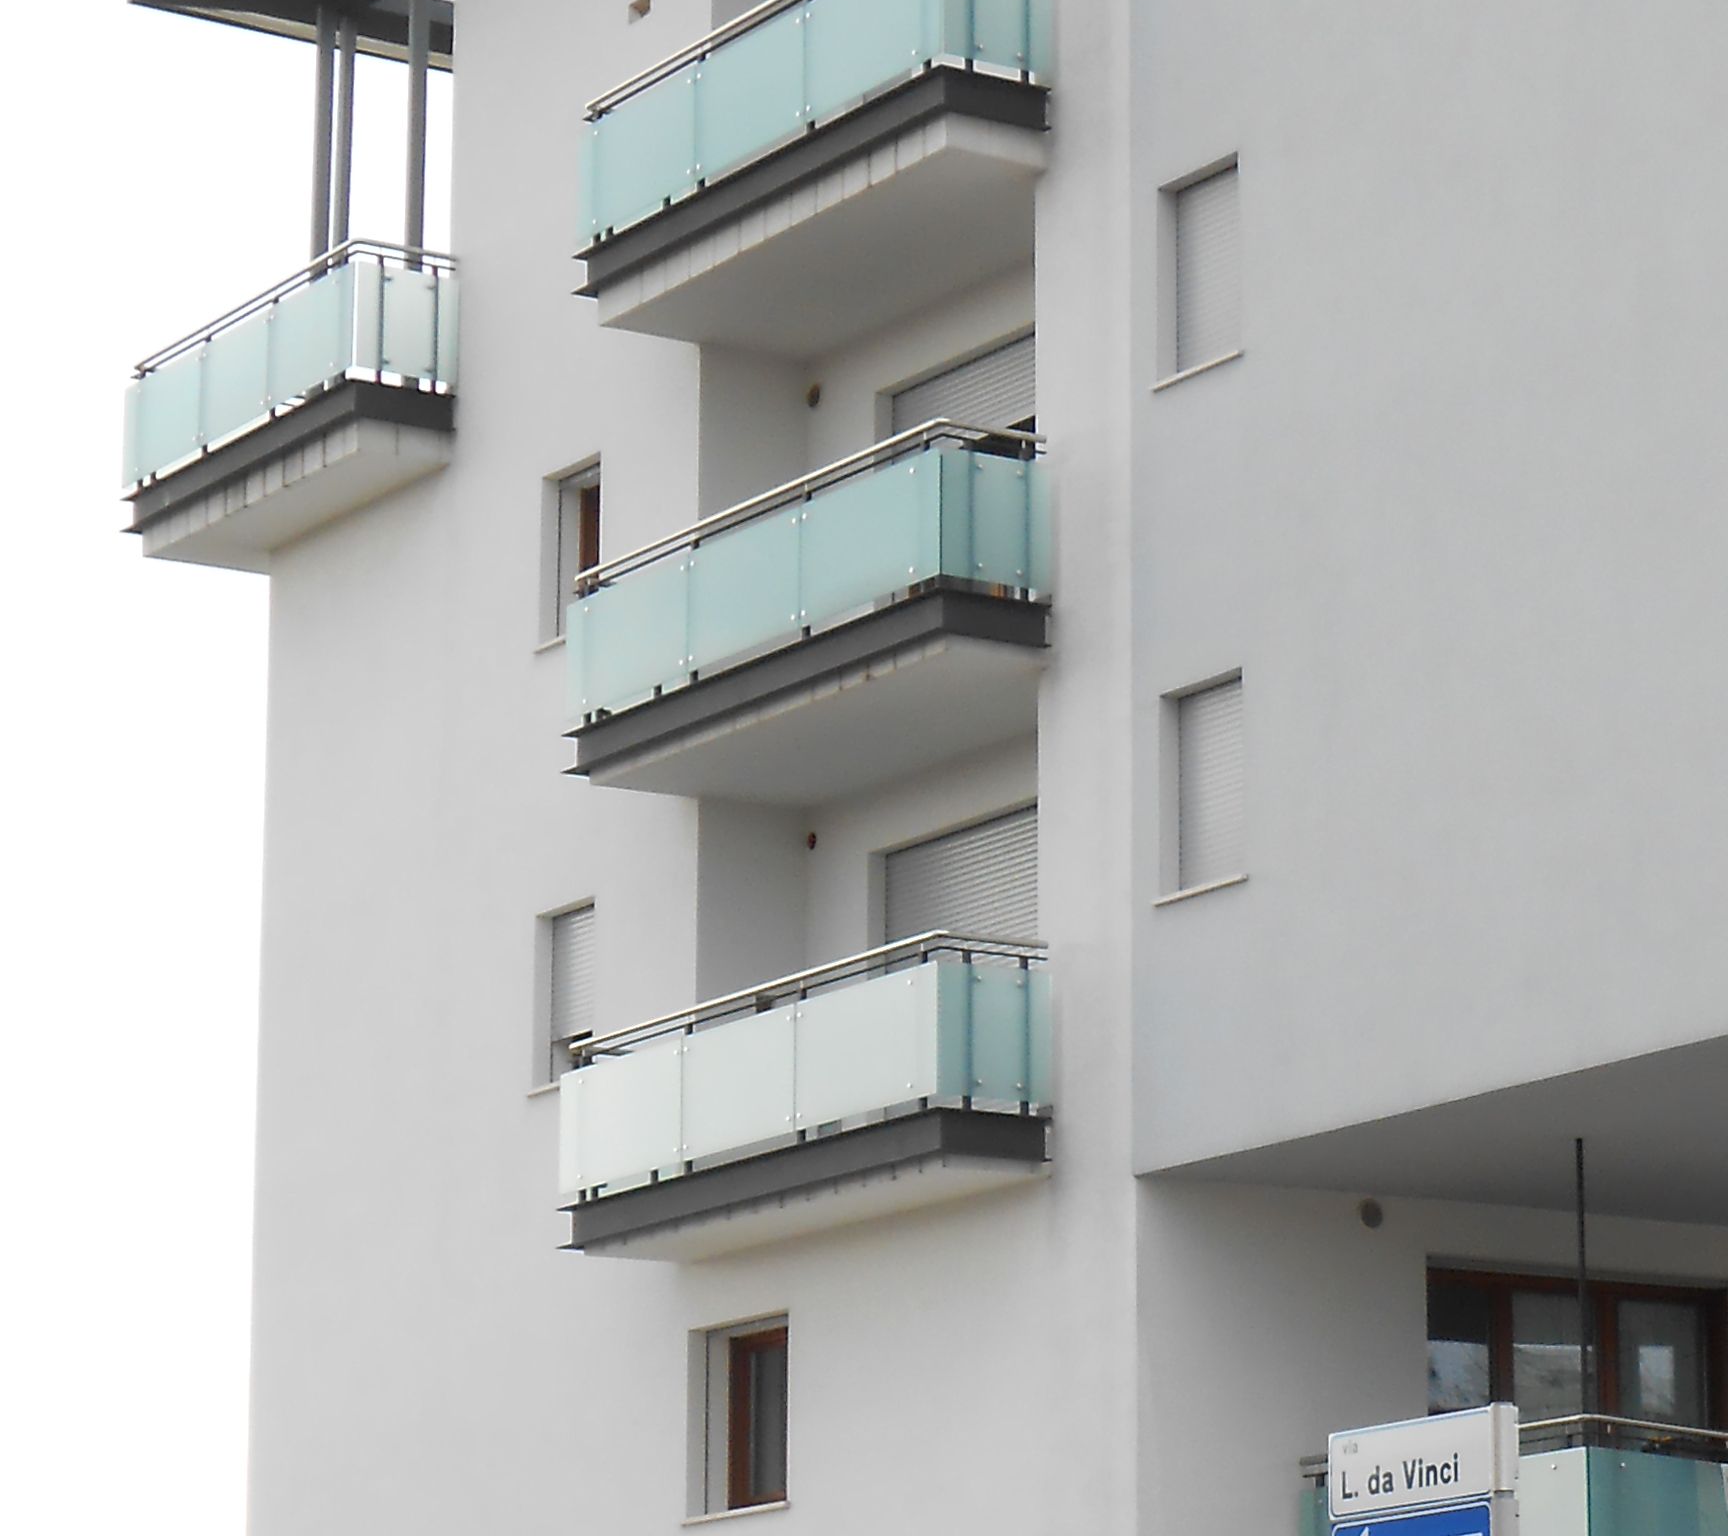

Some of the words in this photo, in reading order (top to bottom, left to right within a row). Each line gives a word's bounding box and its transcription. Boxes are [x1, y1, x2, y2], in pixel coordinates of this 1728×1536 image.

[1342, 1440, 1358, 1454] via
[1342, 1471, 1358, 1499] L.
[1368, 1465, 1394, 1495] da
[1402, 1452, 1459, 1490] Vinci
